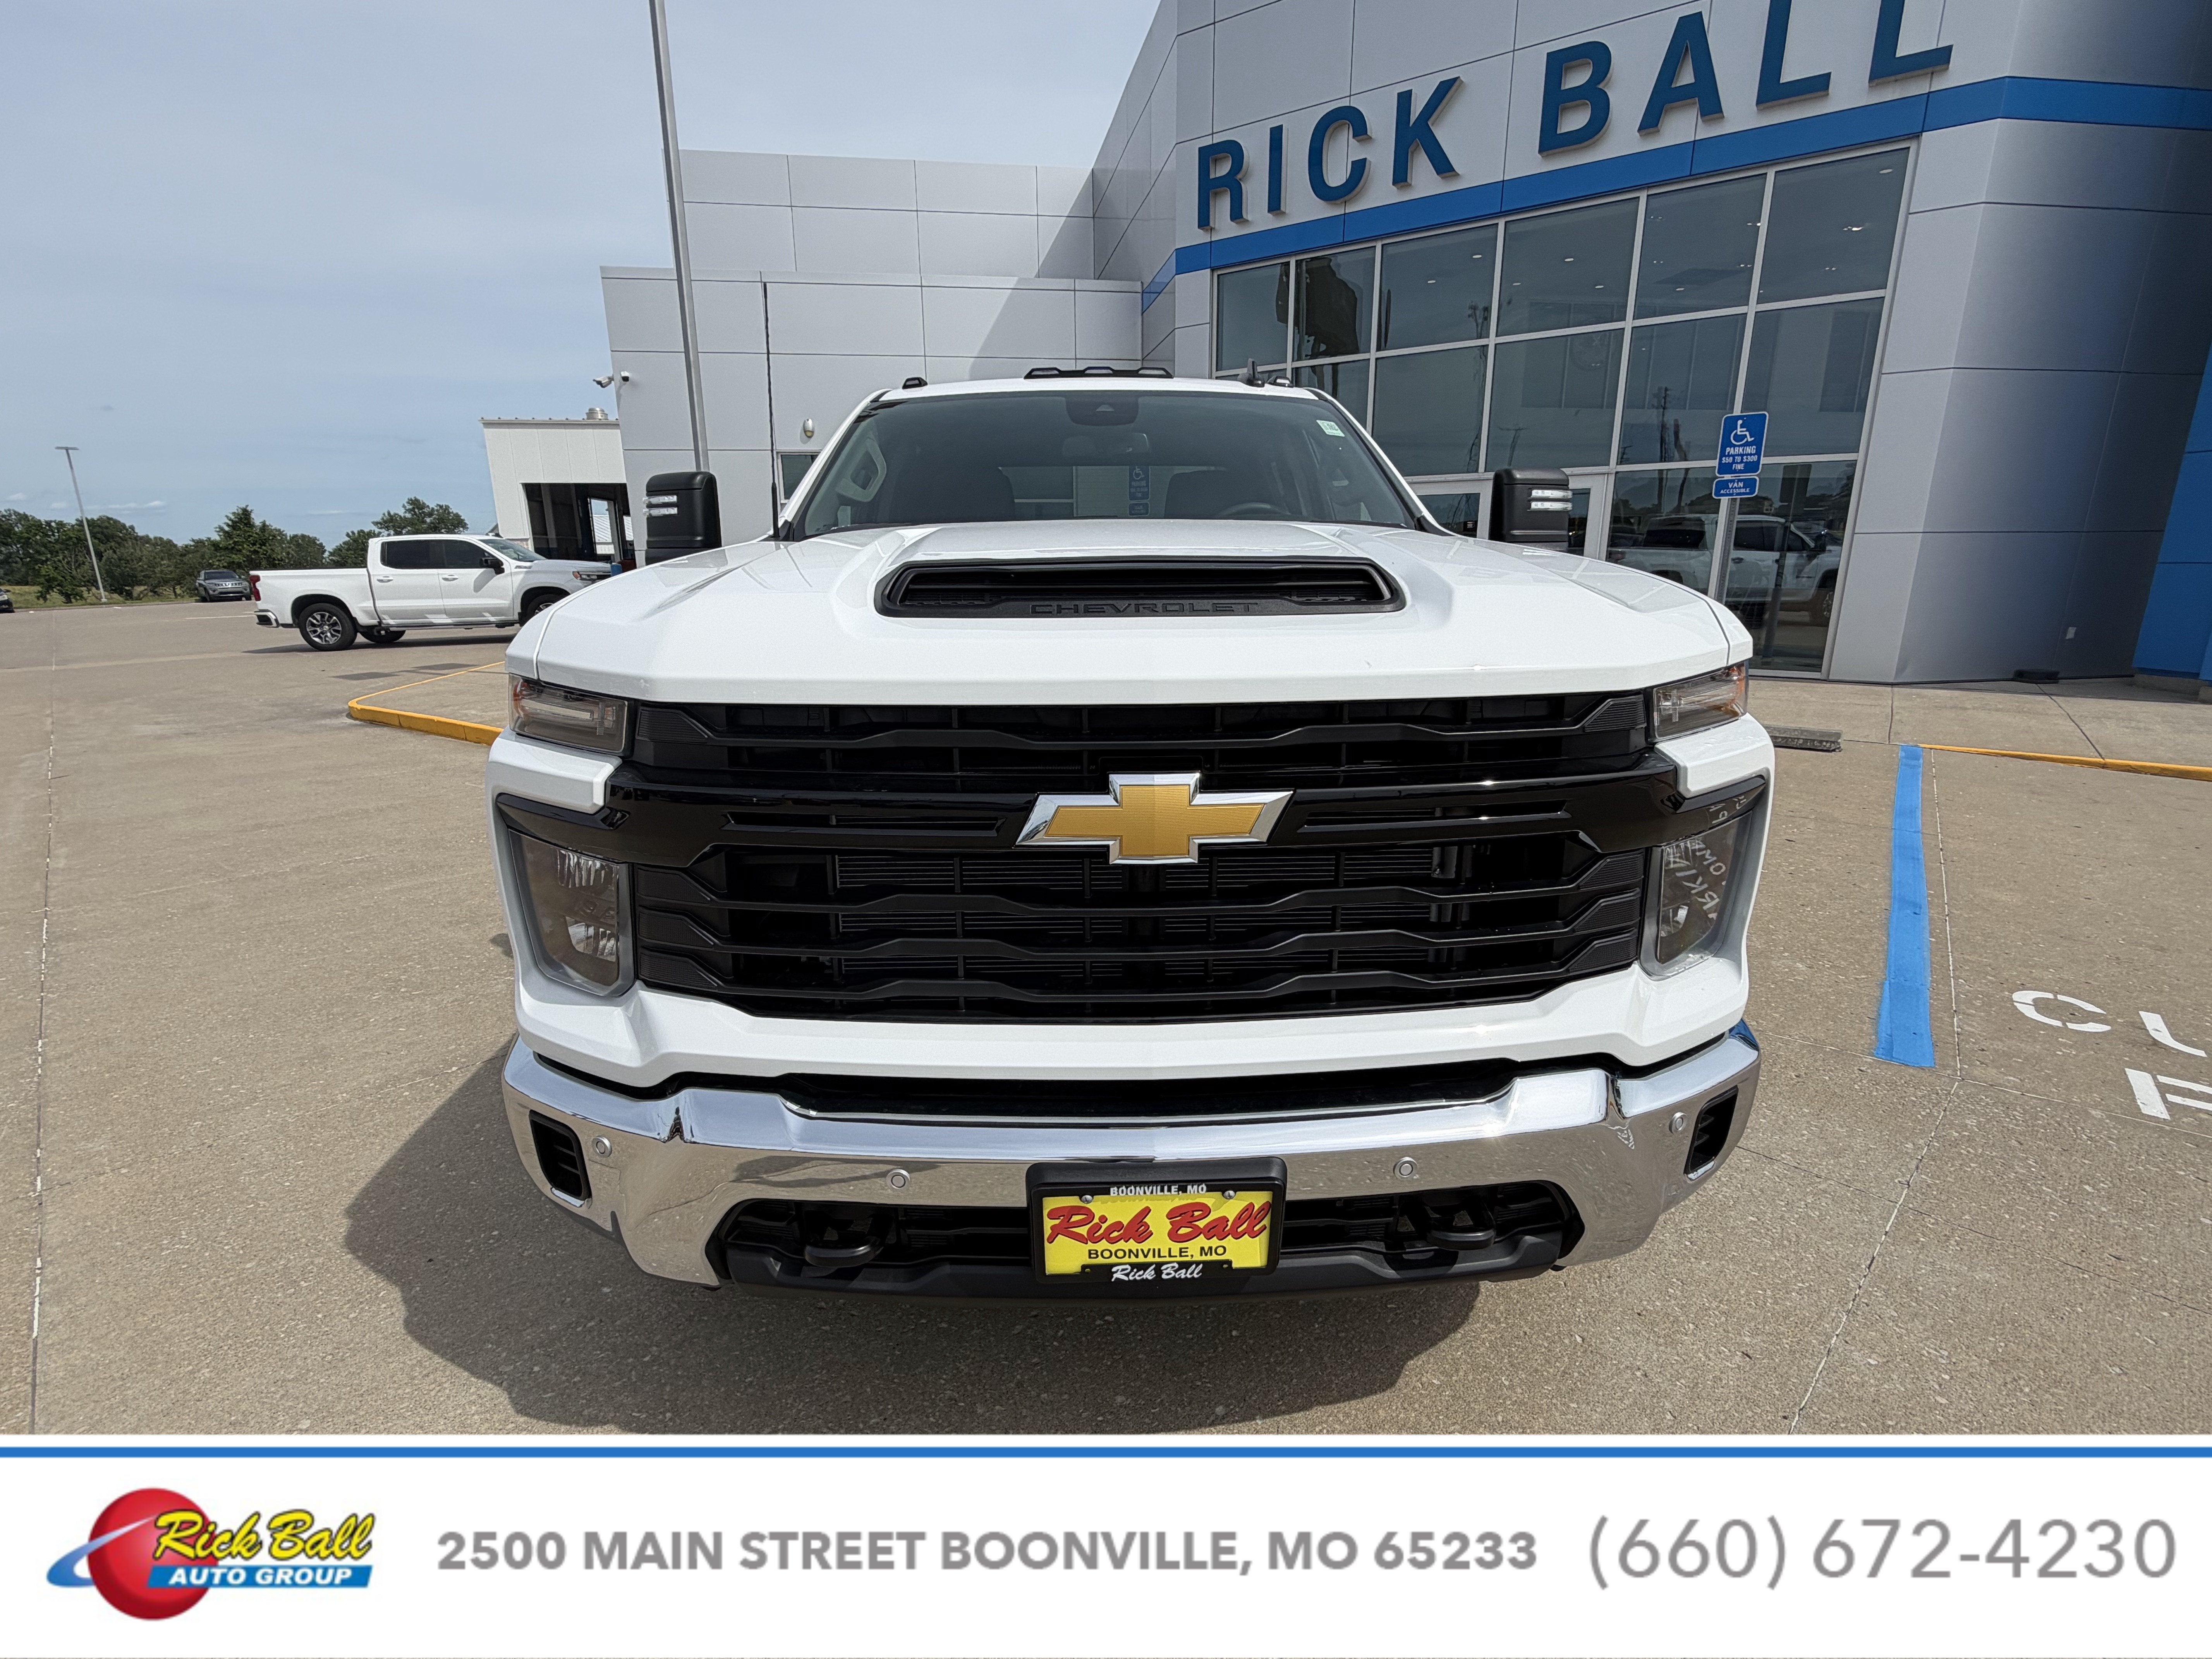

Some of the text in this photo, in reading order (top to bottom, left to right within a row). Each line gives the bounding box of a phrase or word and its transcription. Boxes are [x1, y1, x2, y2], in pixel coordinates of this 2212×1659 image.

[1198, 0, 1953, 230] RICK BALL
[1726, 446, 1756, 455] PARKING
[1030, 603, 1259, 614] CHEVROLET
[1109, 1183, 1207, 1196] BOONVILLE, MO
[1046, 1201, 1272, 1245] Rick Ball
[1087, 1245, 1227, 1260] BOONVILLE, MO
[1111, 1262, 1203, 1282] Rick Ball
